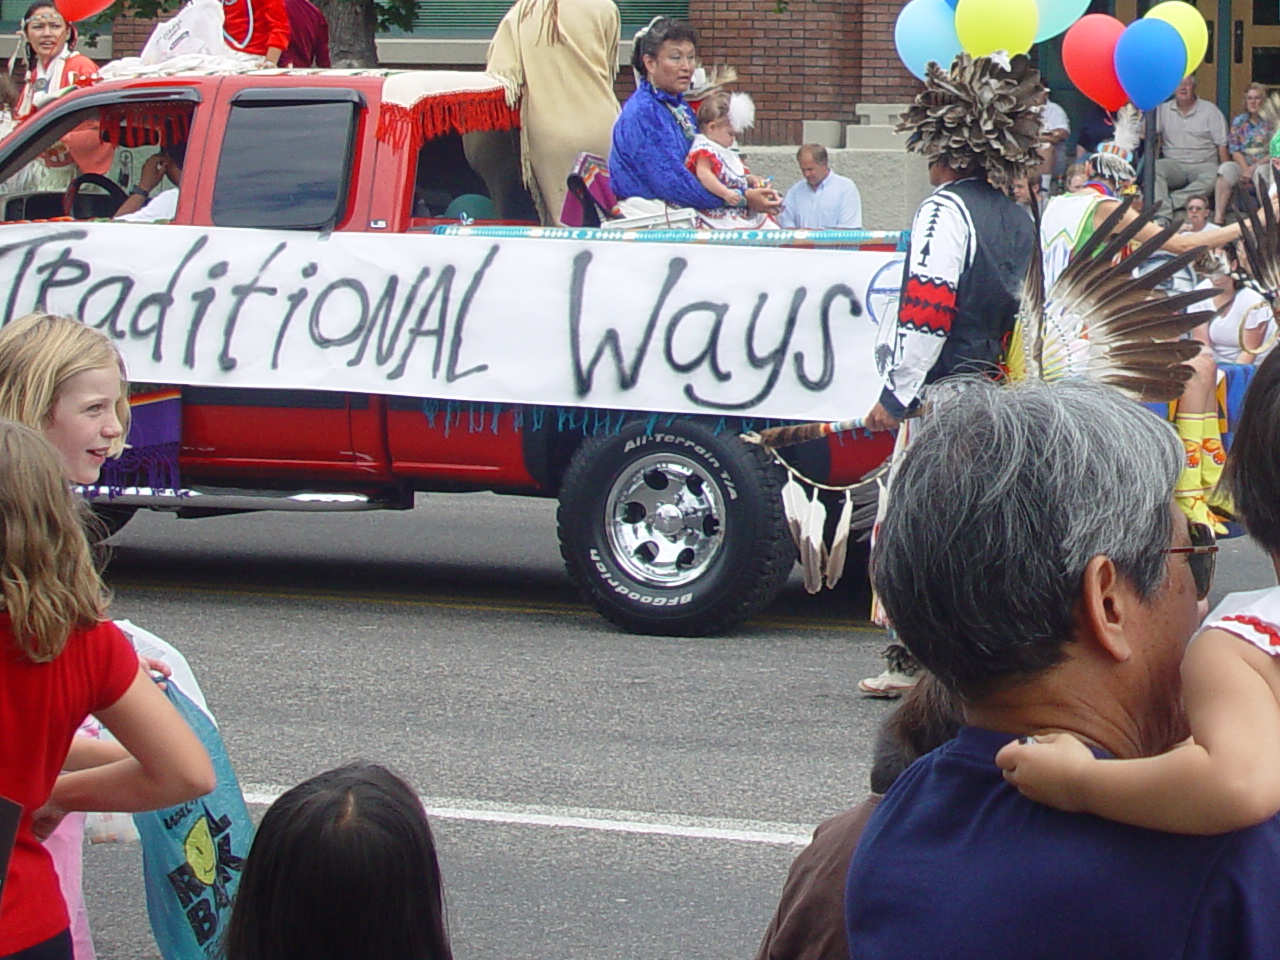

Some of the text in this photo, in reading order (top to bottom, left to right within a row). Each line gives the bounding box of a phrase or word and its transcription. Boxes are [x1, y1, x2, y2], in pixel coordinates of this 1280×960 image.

[569, 249, 862, 410] Ways
[624, 433, 738, 500] All-Terrain T/A
[589, 548, 693, 606] BFGoodrich
